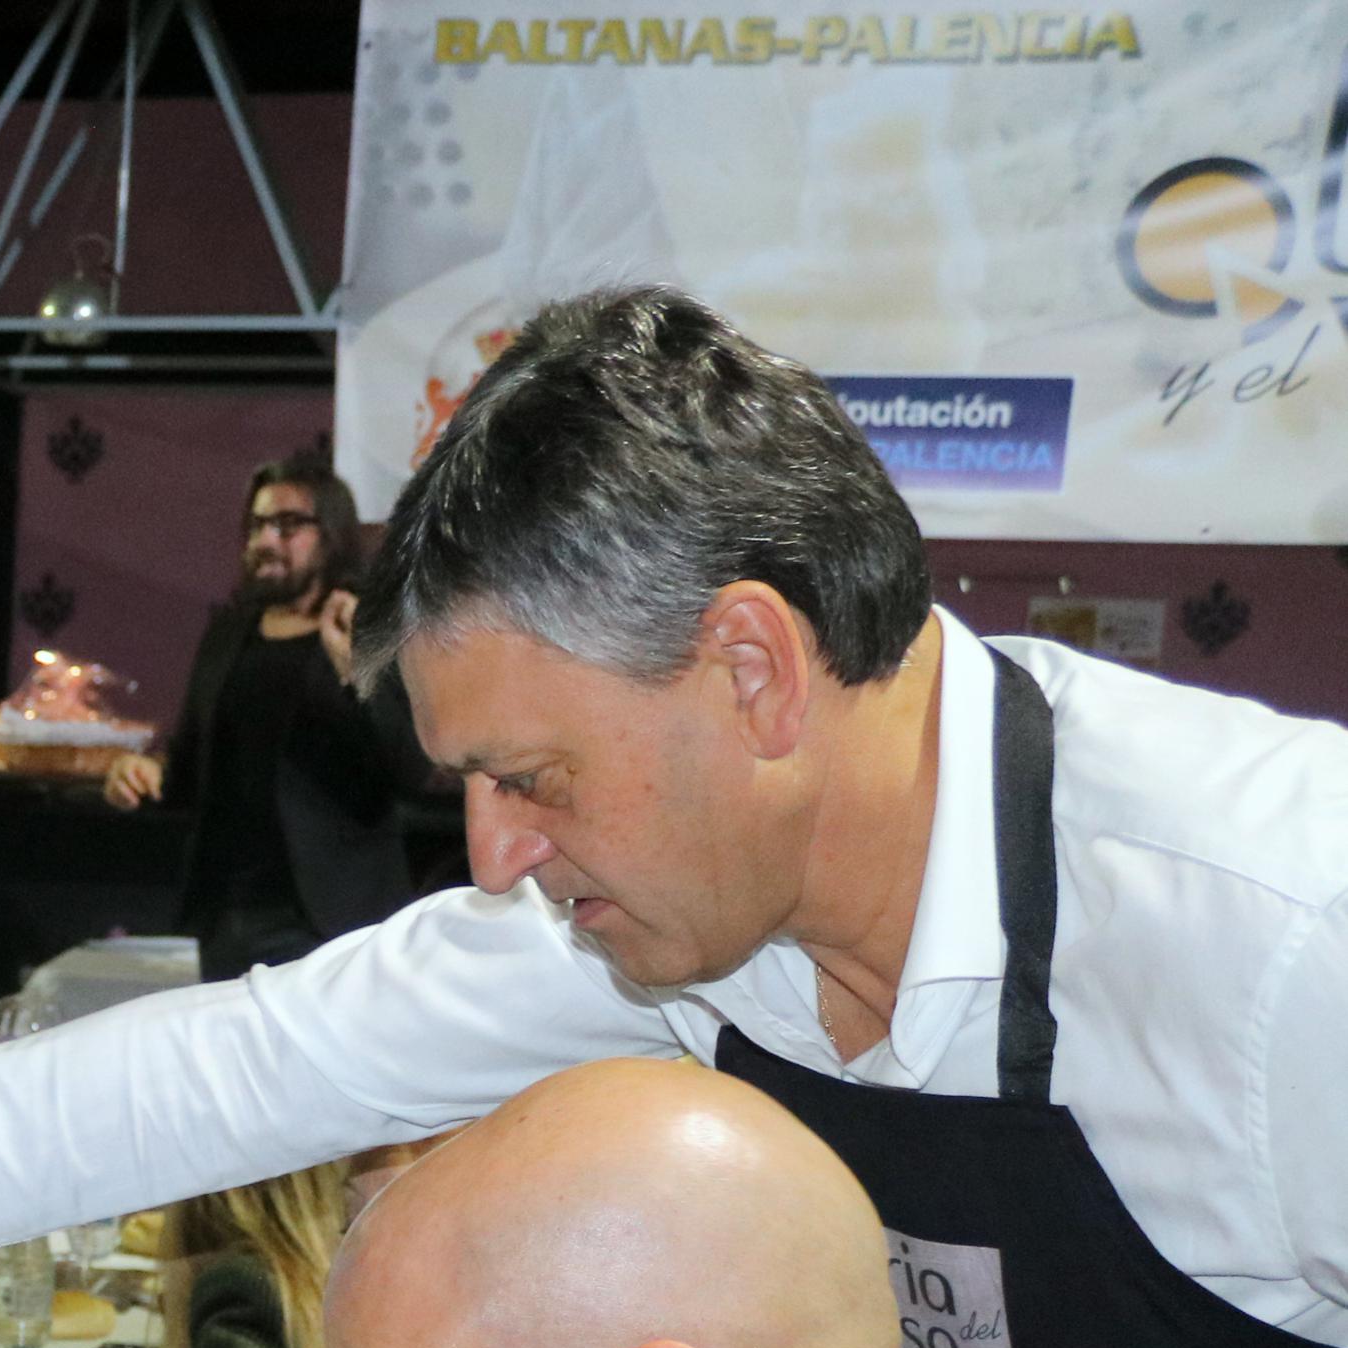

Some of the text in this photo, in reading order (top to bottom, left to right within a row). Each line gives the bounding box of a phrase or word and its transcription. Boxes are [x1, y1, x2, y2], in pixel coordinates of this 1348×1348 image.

[1160, 323, 1310, 427] y el
[959, 1309, 1002, 1340] del
